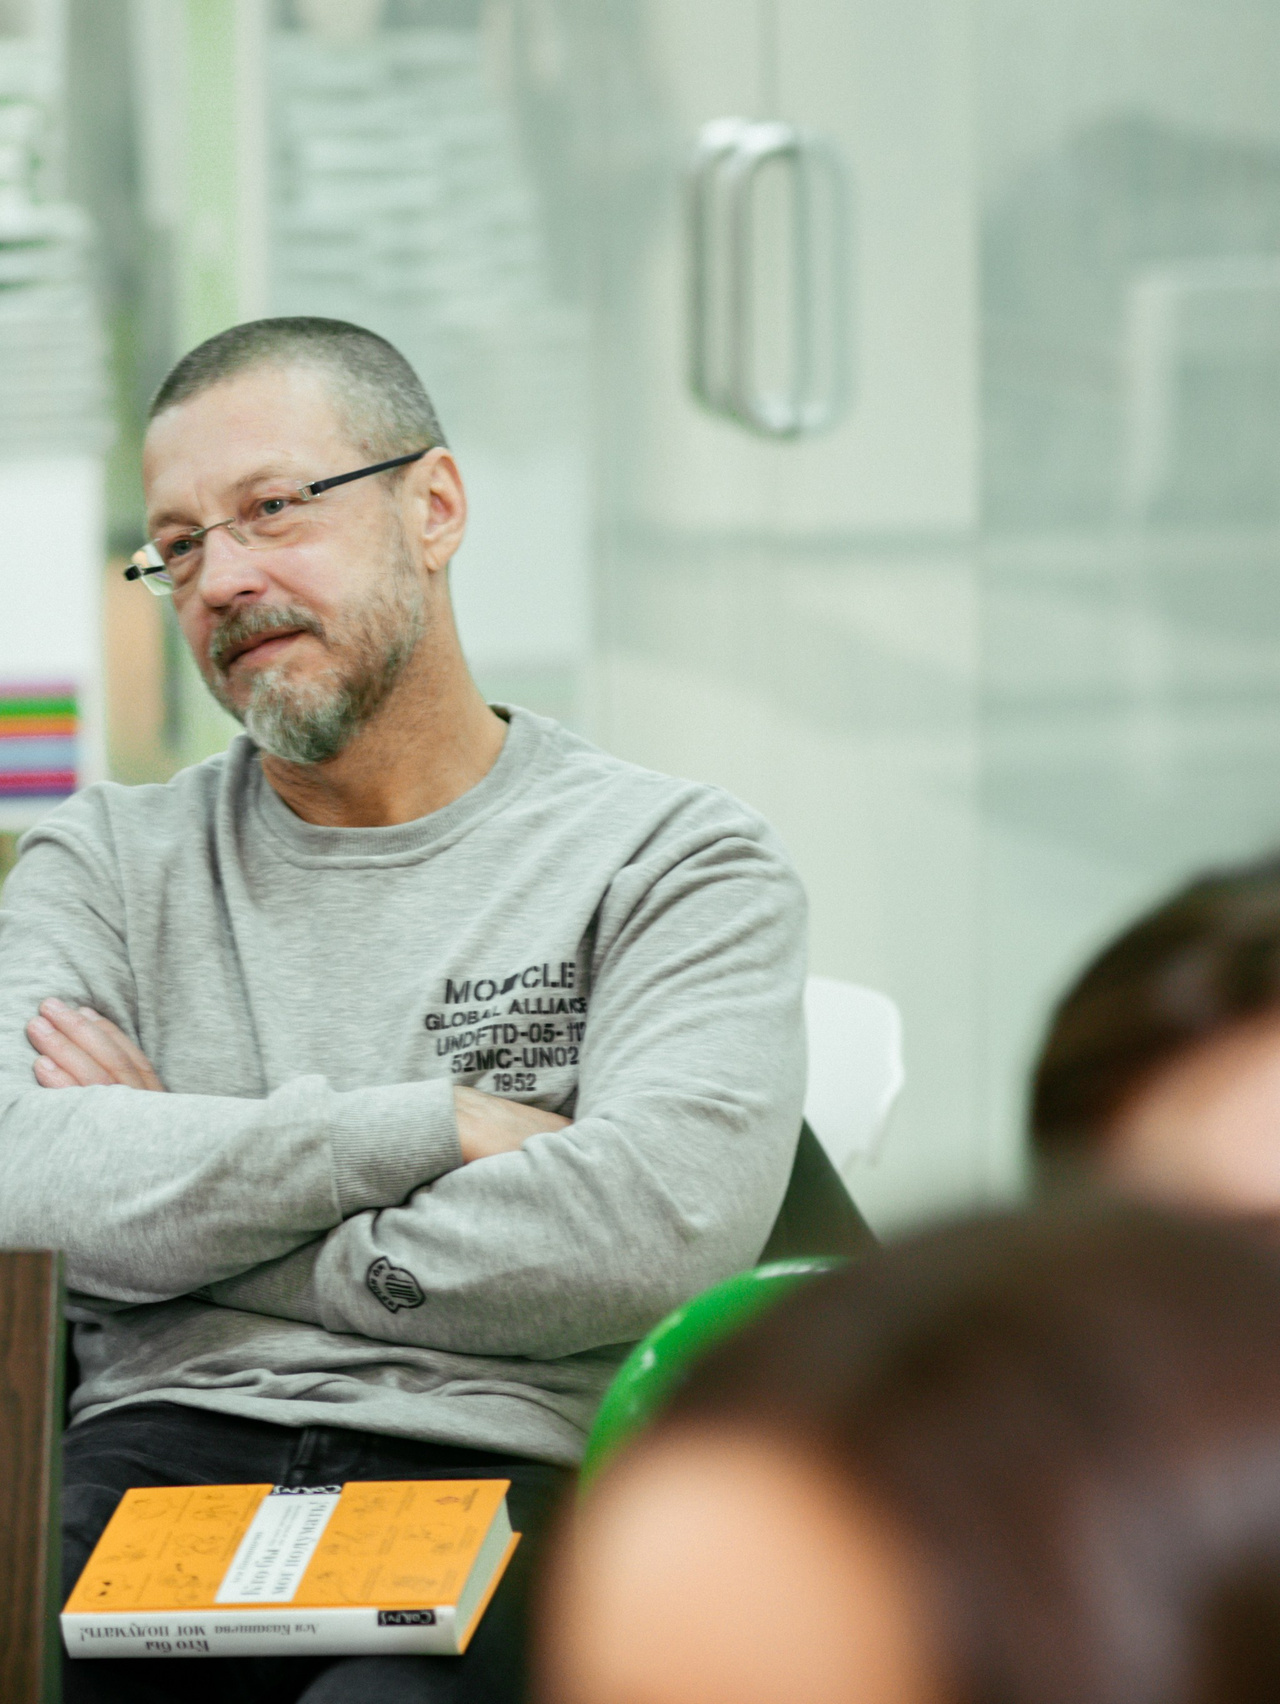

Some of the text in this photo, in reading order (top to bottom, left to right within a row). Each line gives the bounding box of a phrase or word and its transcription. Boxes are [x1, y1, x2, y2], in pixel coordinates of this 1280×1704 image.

[493, 1073, 537, 1092] 1952
[80, 1623, 207, 1642] мог подумать!
[145, 1640, 210, 1653] Кто бы
